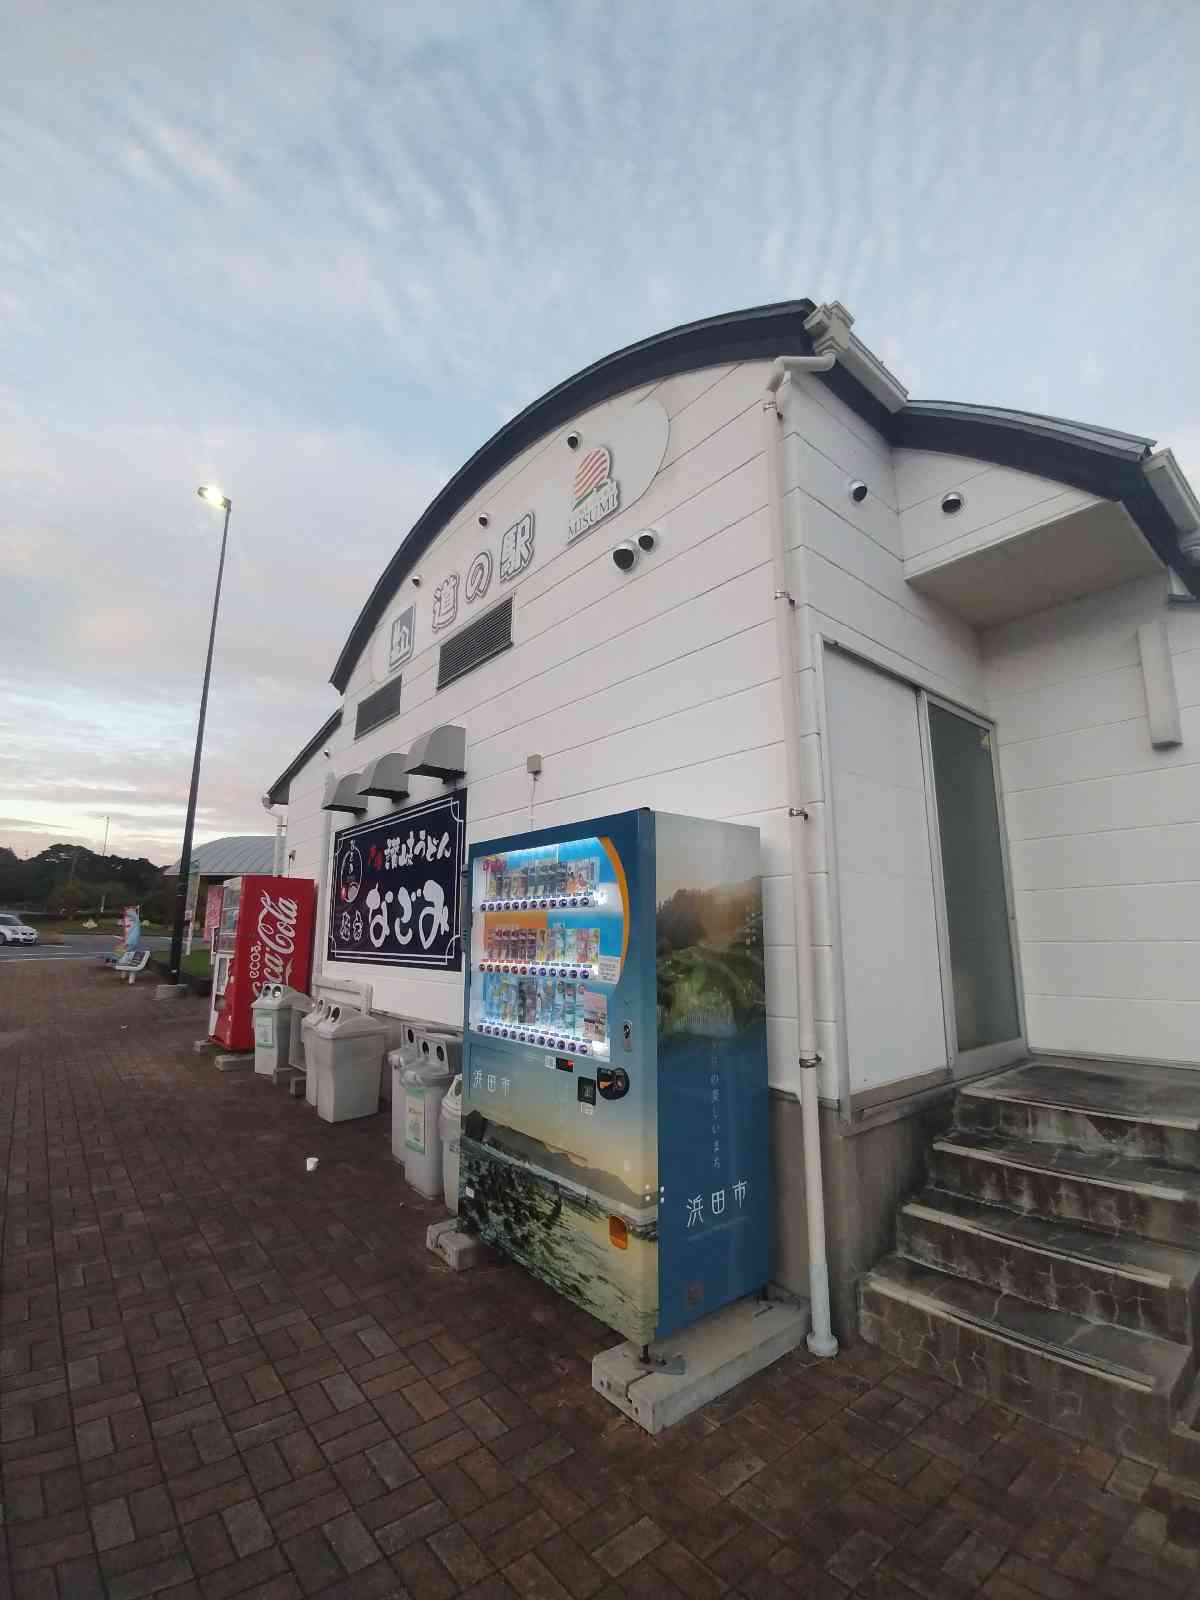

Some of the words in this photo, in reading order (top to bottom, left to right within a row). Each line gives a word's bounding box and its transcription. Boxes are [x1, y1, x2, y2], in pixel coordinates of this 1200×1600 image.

[567, 494, 619, 540] MISUMI
[431, 511, 536, 633] 道の駅
[384, 829, 451, 870] 讃岐うどん
[365, 880, 450, 950] なごみ
[252, 889, 298, 998] Cca-Cola
[471, 1069, 511, 1097] 浜田市
[686, 1179, 748, 1228] 浜田市
